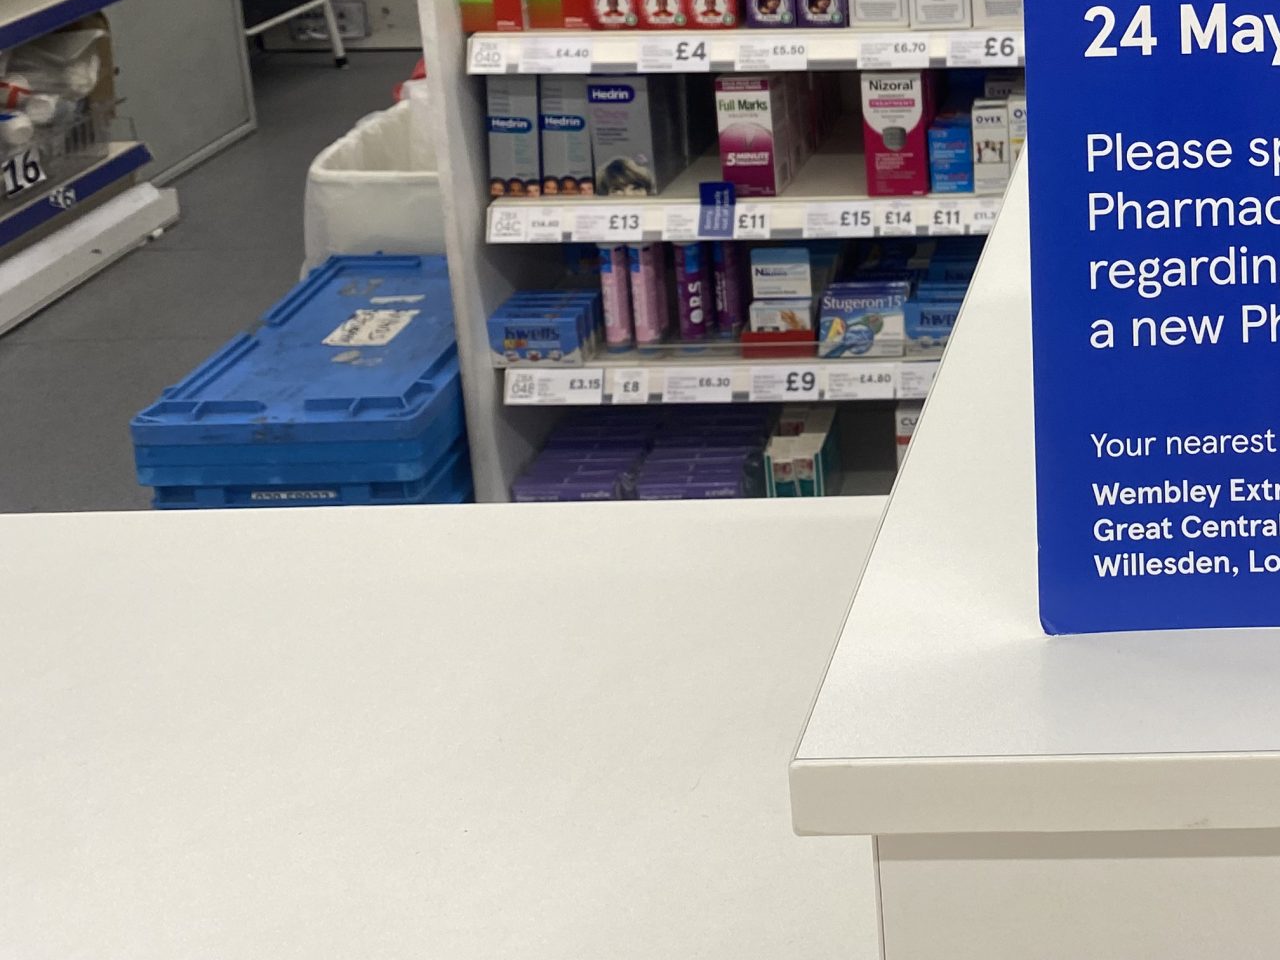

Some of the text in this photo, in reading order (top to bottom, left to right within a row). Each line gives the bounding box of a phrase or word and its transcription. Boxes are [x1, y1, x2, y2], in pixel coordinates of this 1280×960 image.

[1083, 4, 1158, 58] 24
[556, 49, 589, 58] £4.40
[676, 42, 706, 60] £4
[773, 46, 805, 55] £5.50
[894, 43, 926, 53] £6.70
[985, 37, 1014, 57] £6
[869, 80, 913, 91] Nizoral
[592, 90, 629, 100] Hedrin
[718, 99, 768, 111] Full Marks
[976, 116, 1001, 124] OVEX
[726, 153, 735, 165] 5
[1087, 132, 1233, 172] Please
[4, 150, 40, 194] 16
[609, 215, 640, 229] £13
[739, 214, 765, 228] £11
[841, 211, 870, 226] £15
[885, 211, 911, 224] £14
[934, 211, 960, 225] £11
[689, 282, 703, 323] ORS
[823, 296, 883, 312] Stugeron
[1089, 319, 1114, 349] a
[1132, 315, 1225, 347] new
[569, 379, 601, 390] £3.15
[699, 378, 730, 388] £6.30
[786, 372, 815, 391] £9
[860, 374, 891, 383] £4.80
[623, 381, 639, 393] £8
[1090, 433, 1157, 458] Your
[1166, 428, 1277, 455] nearest
[1091, 479, 1222, 509] Wembley
[1093, 517, 1174, 542] Great
[1093, 550, 1239, 578] Willesden,
